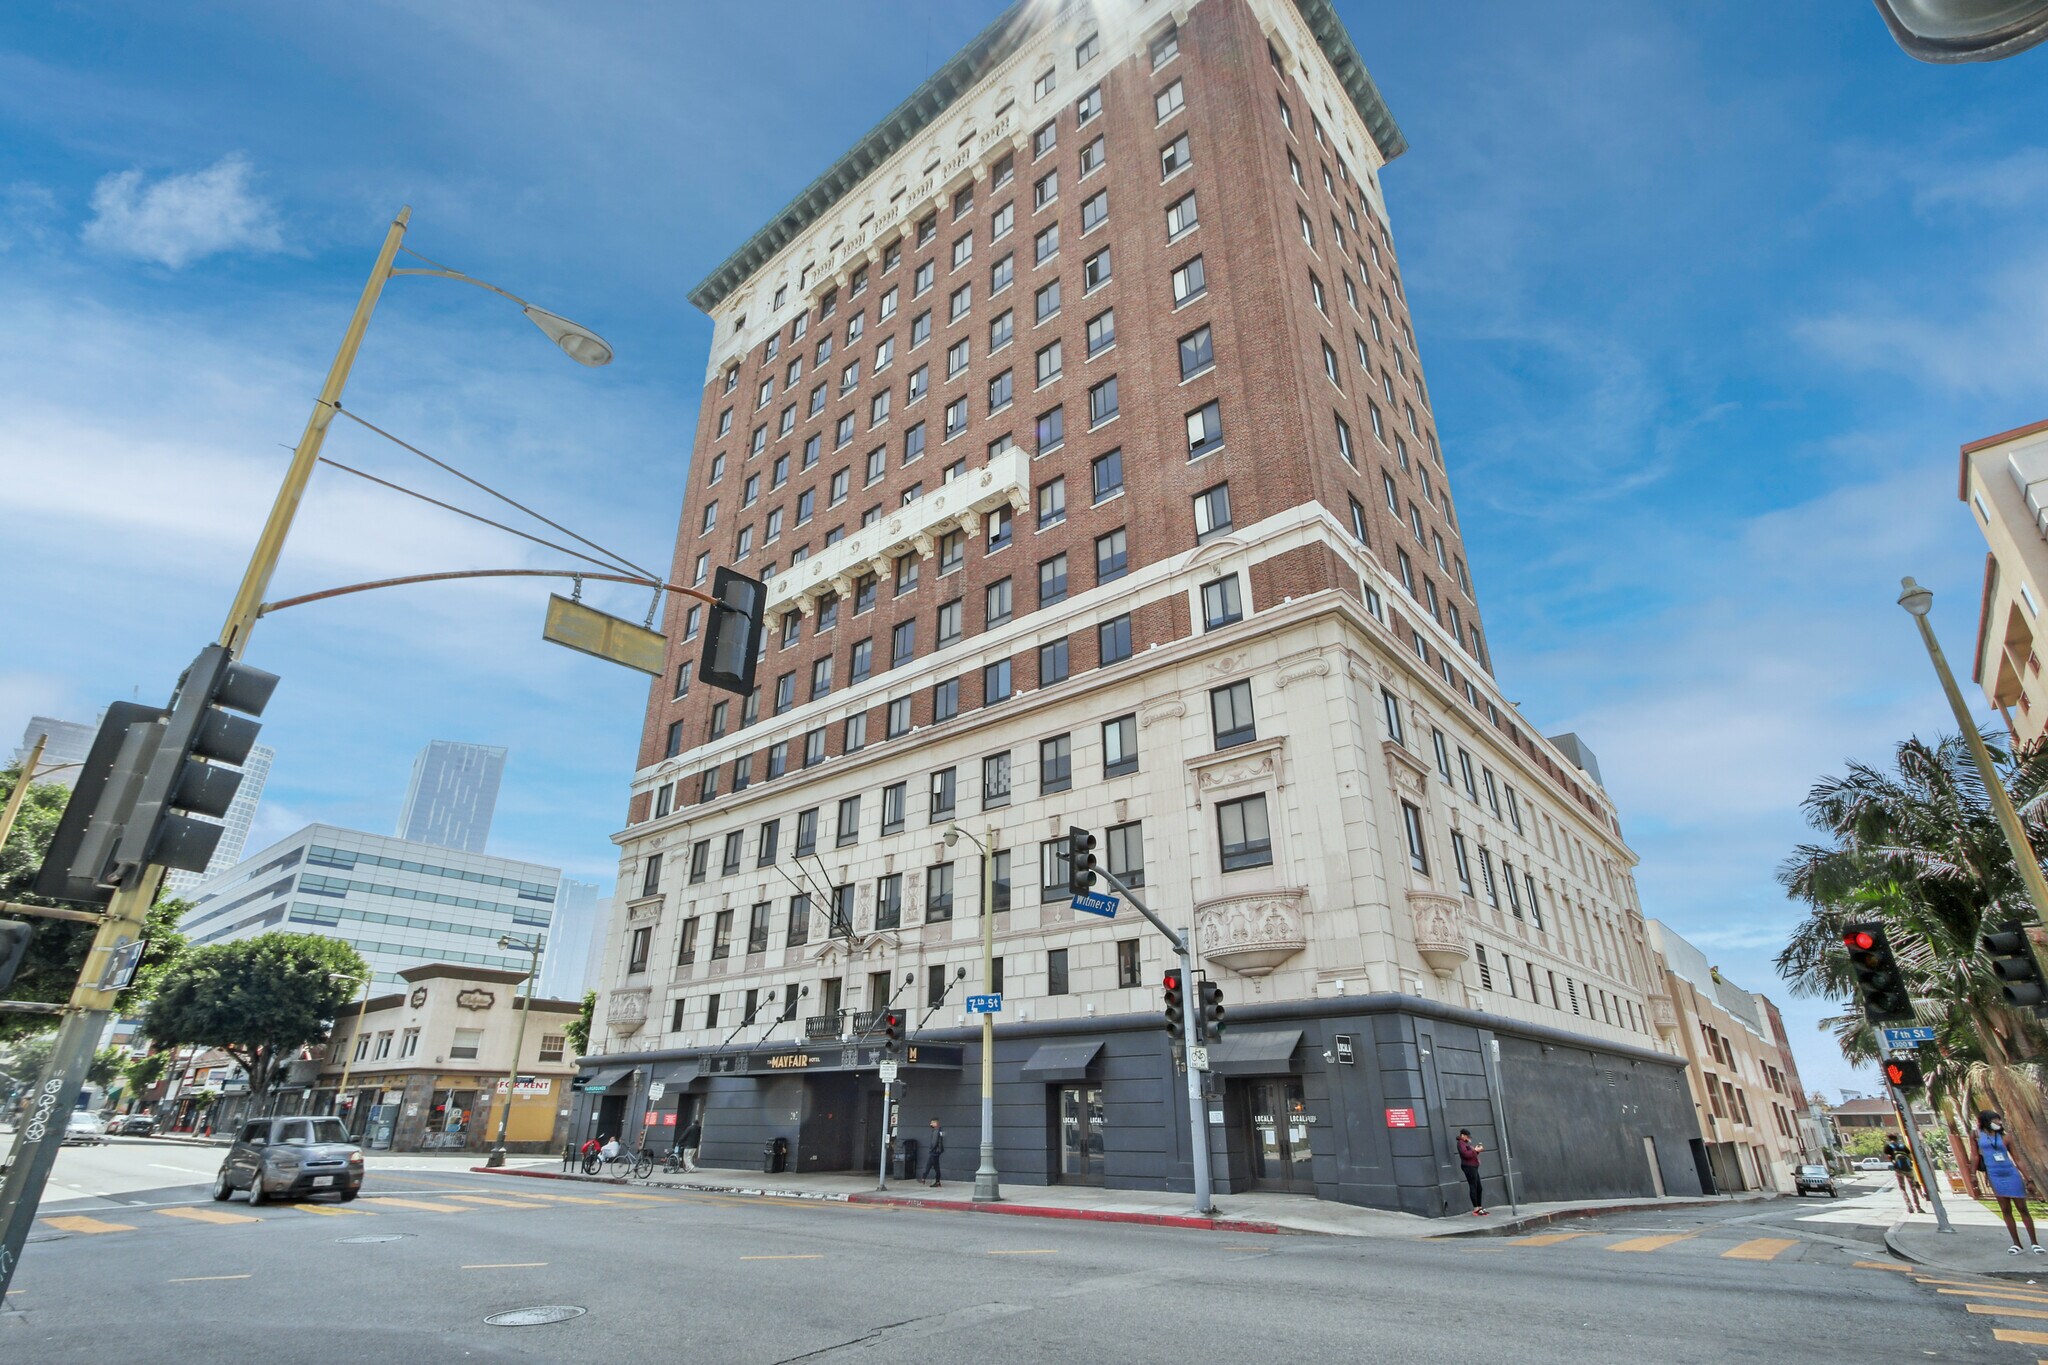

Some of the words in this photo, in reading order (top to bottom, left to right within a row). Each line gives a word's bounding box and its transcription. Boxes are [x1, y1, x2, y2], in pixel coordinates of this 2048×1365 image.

[1105, 901, 1116, 913] St
[969, 998, 985, 1013] 7th
[987, 998, 999, 1009] St
[1891, 1030, 1910, 1039] 7th
[1912, 1029, 1926, 1038] St
[909, 1047, 917, 1059] M
[771, 1055, 808, 1068] MAYFAIR
[523, 1081, 549, 1089] RENT
